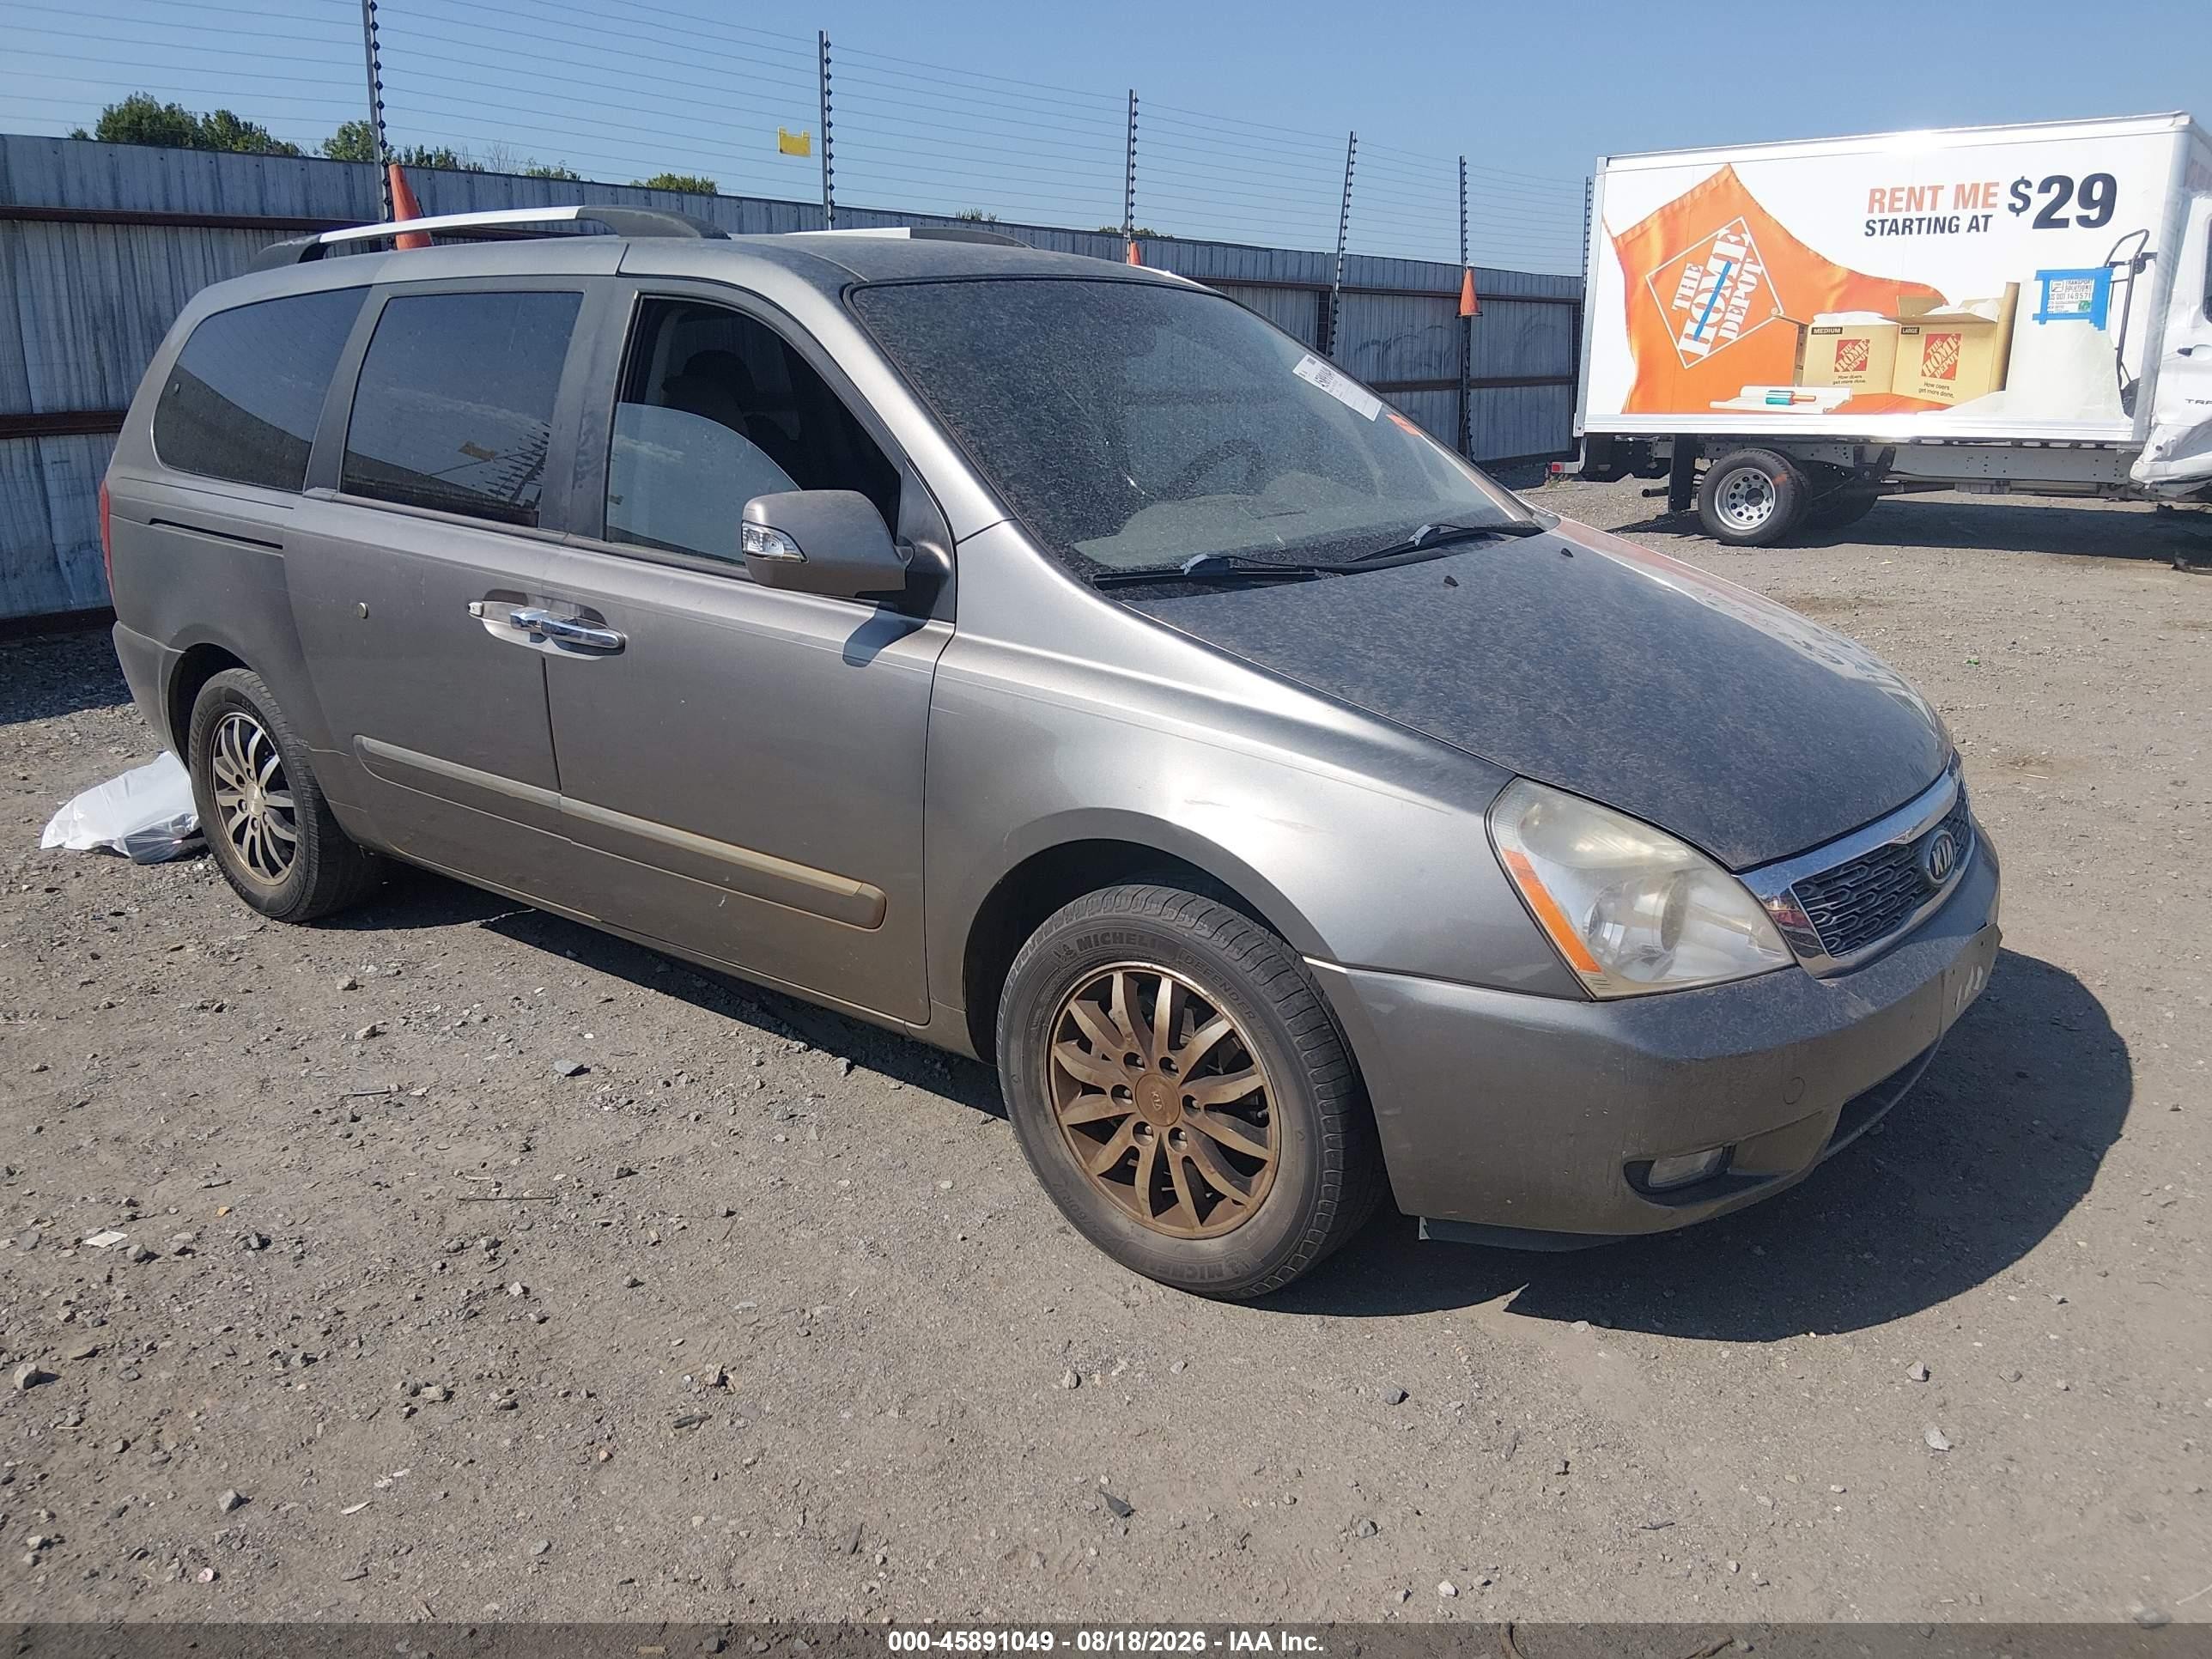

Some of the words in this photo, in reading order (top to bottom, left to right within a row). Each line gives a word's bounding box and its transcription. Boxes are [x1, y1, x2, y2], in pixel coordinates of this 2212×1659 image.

[1868, 185, 1944, 214] RENT
[1954, 181, 2000, 210] ME
[2008, 173, 2118, 229] $29
[1864, 216, 1960, 237] STARTING
[1966, 215, 1993, 234] AT
[1672, 263, 1705, 310] THE
[1679, 227, 1752, 356] HOME
[1717, 258, 1763, 340] DEPOT
[1834, 339, 1869, 373] HOME
[1922, 334, 1962, 376] HOME
[1927, 338, 1943, 356] THE
[1934, 350, 1959, 378] DEPOT
[1932, 839, 1954, 876] KIA
[1075, 931, 1170, 954] MICHELI
[1184, 952, 1256, 1019] DEFENDER
